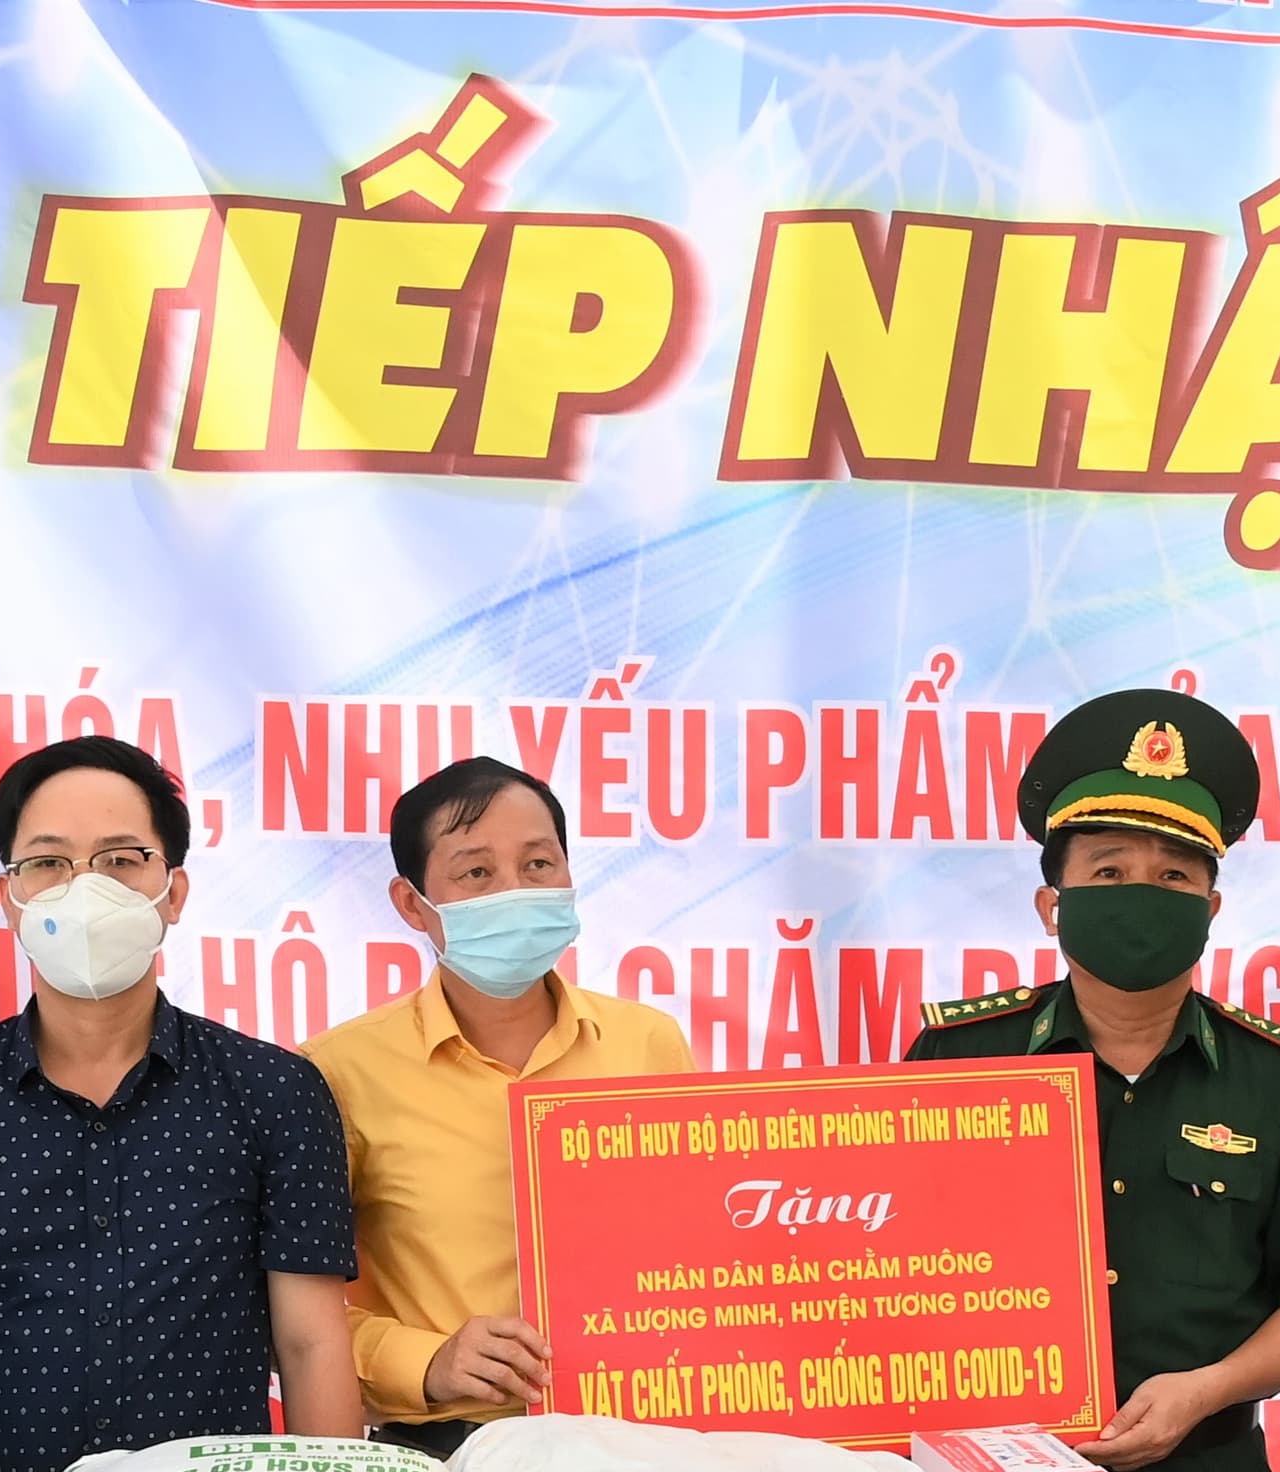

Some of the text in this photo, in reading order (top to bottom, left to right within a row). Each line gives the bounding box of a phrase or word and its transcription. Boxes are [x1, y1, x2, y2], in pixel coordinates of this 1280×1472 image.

[27, 75, 697, 480] TIẾP
[510, 663, 706, 840] YẾU
[744, 653, 1045, 842] PHẨM
[560, 1097, 1049, 1168] BỘ CHỈ HUY BỘ ĐỘI BIÊN PHÒNG TỈNH NGHỆ AN
[724, 1180, 898, 1235] Tặng
[636, 1262, 706, 1294] NHÂN
[714, 1260, 764, 1290] DÂN
[771, 1255, 820, 1286] BẢN
[908, 1248, 993, 1276] PUÔNG
[583, 1288, 1051, 1338] XÃ LƯỢNG MINH, HUYỆN TƯƠNG DƯƠNG
[631, 1348, 693, 1420] CHẤT
[701, 1350, 794, 1418] PHÒNG,
[799, 1338, 884, 1408] CHỐNG
[891, 1351, 946, 1414] DỊCH
[954, 1344, 1064, 1398] COVID-19
